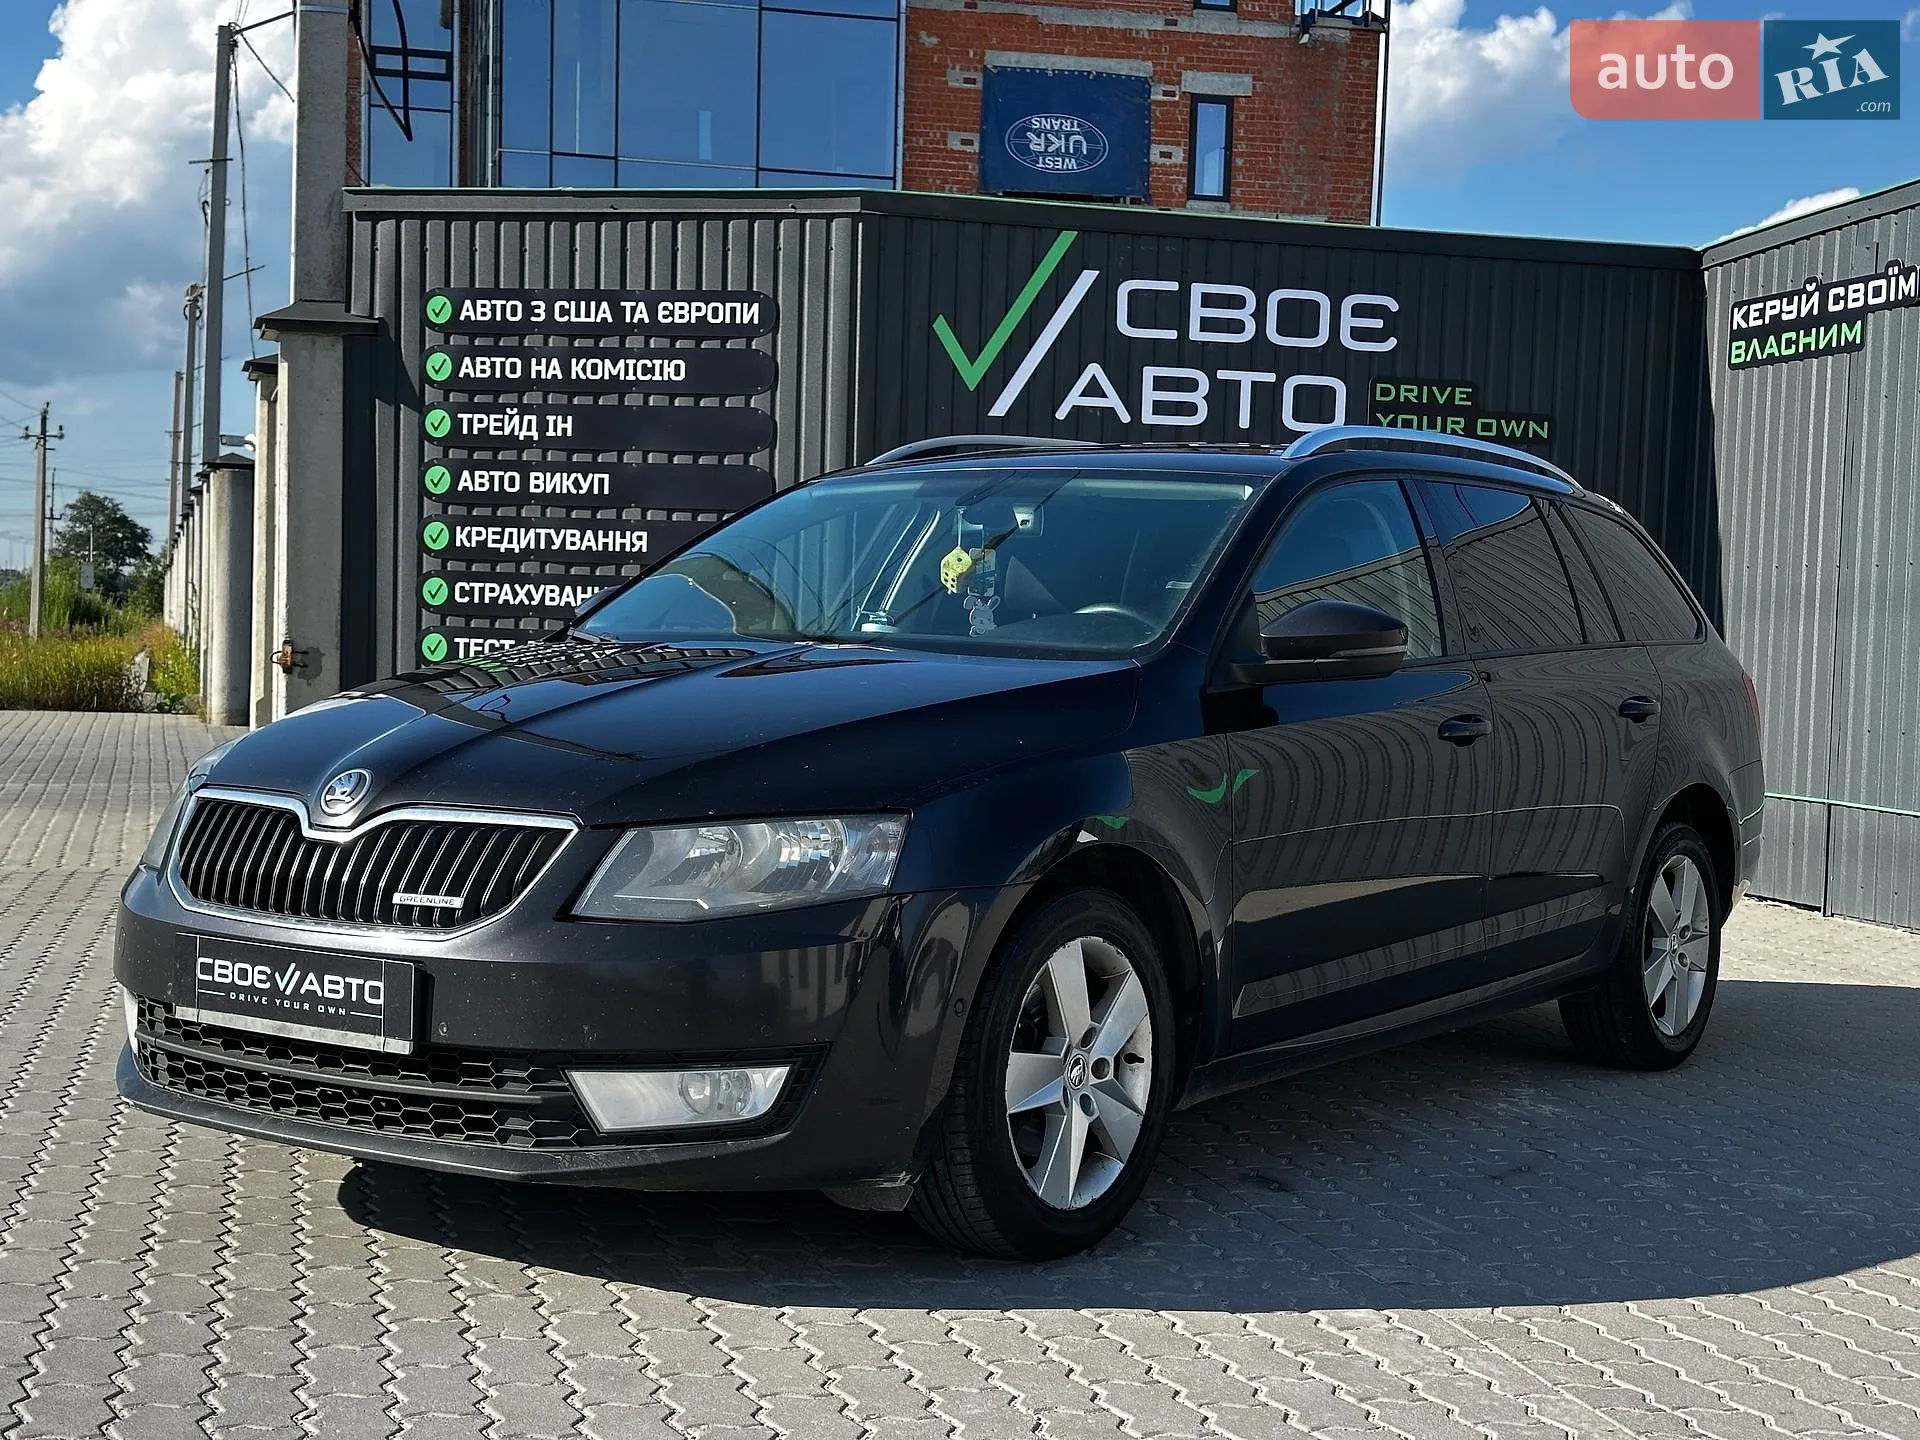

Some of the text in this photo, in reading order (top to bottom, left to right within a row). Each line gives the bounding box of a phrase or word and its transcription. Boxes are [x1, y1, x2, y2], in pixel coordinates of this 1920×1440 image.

[1031, 117, 1080, 131] TRANS
[1026, 131, 1087, 154] UKR
[1036, 156, 1077, 169] WEST
[1732, 265, 1916, 330] КЕРУЙ СВОЇМ
[459, 300, 522, 322] АВТО
[554, 301, 613, 323] США
[621, 302, 649, 323] ТА
[657, 301, 760, 325] ЄВРОПИ
[1116, 278, 1399, 352] СВОЄ
[1730, 320, 1862, 364] ВЛАСНИМ
[458, 357, 686, 381] АВТО НА КОМІСІЮ
[1054, 362, 1347, 432] АВТО
[1376, 383, 1472, 406] DRIVE
[457, 408, 573, 441] ТРЕЙД ІН
[1376, 412, 1549, 439] YOUR OWN
[457, 471, 609, 495] АВТО ВИКУП
[455, 526, 648, 553] КРЕДИТУВАННЯ
[399, 895, 456, 906] GREENLINE
[197, 957, 384, 1005] СВОЄ АВТО
[229, 991, 346, 1015] DRIVE YOUR OWN
